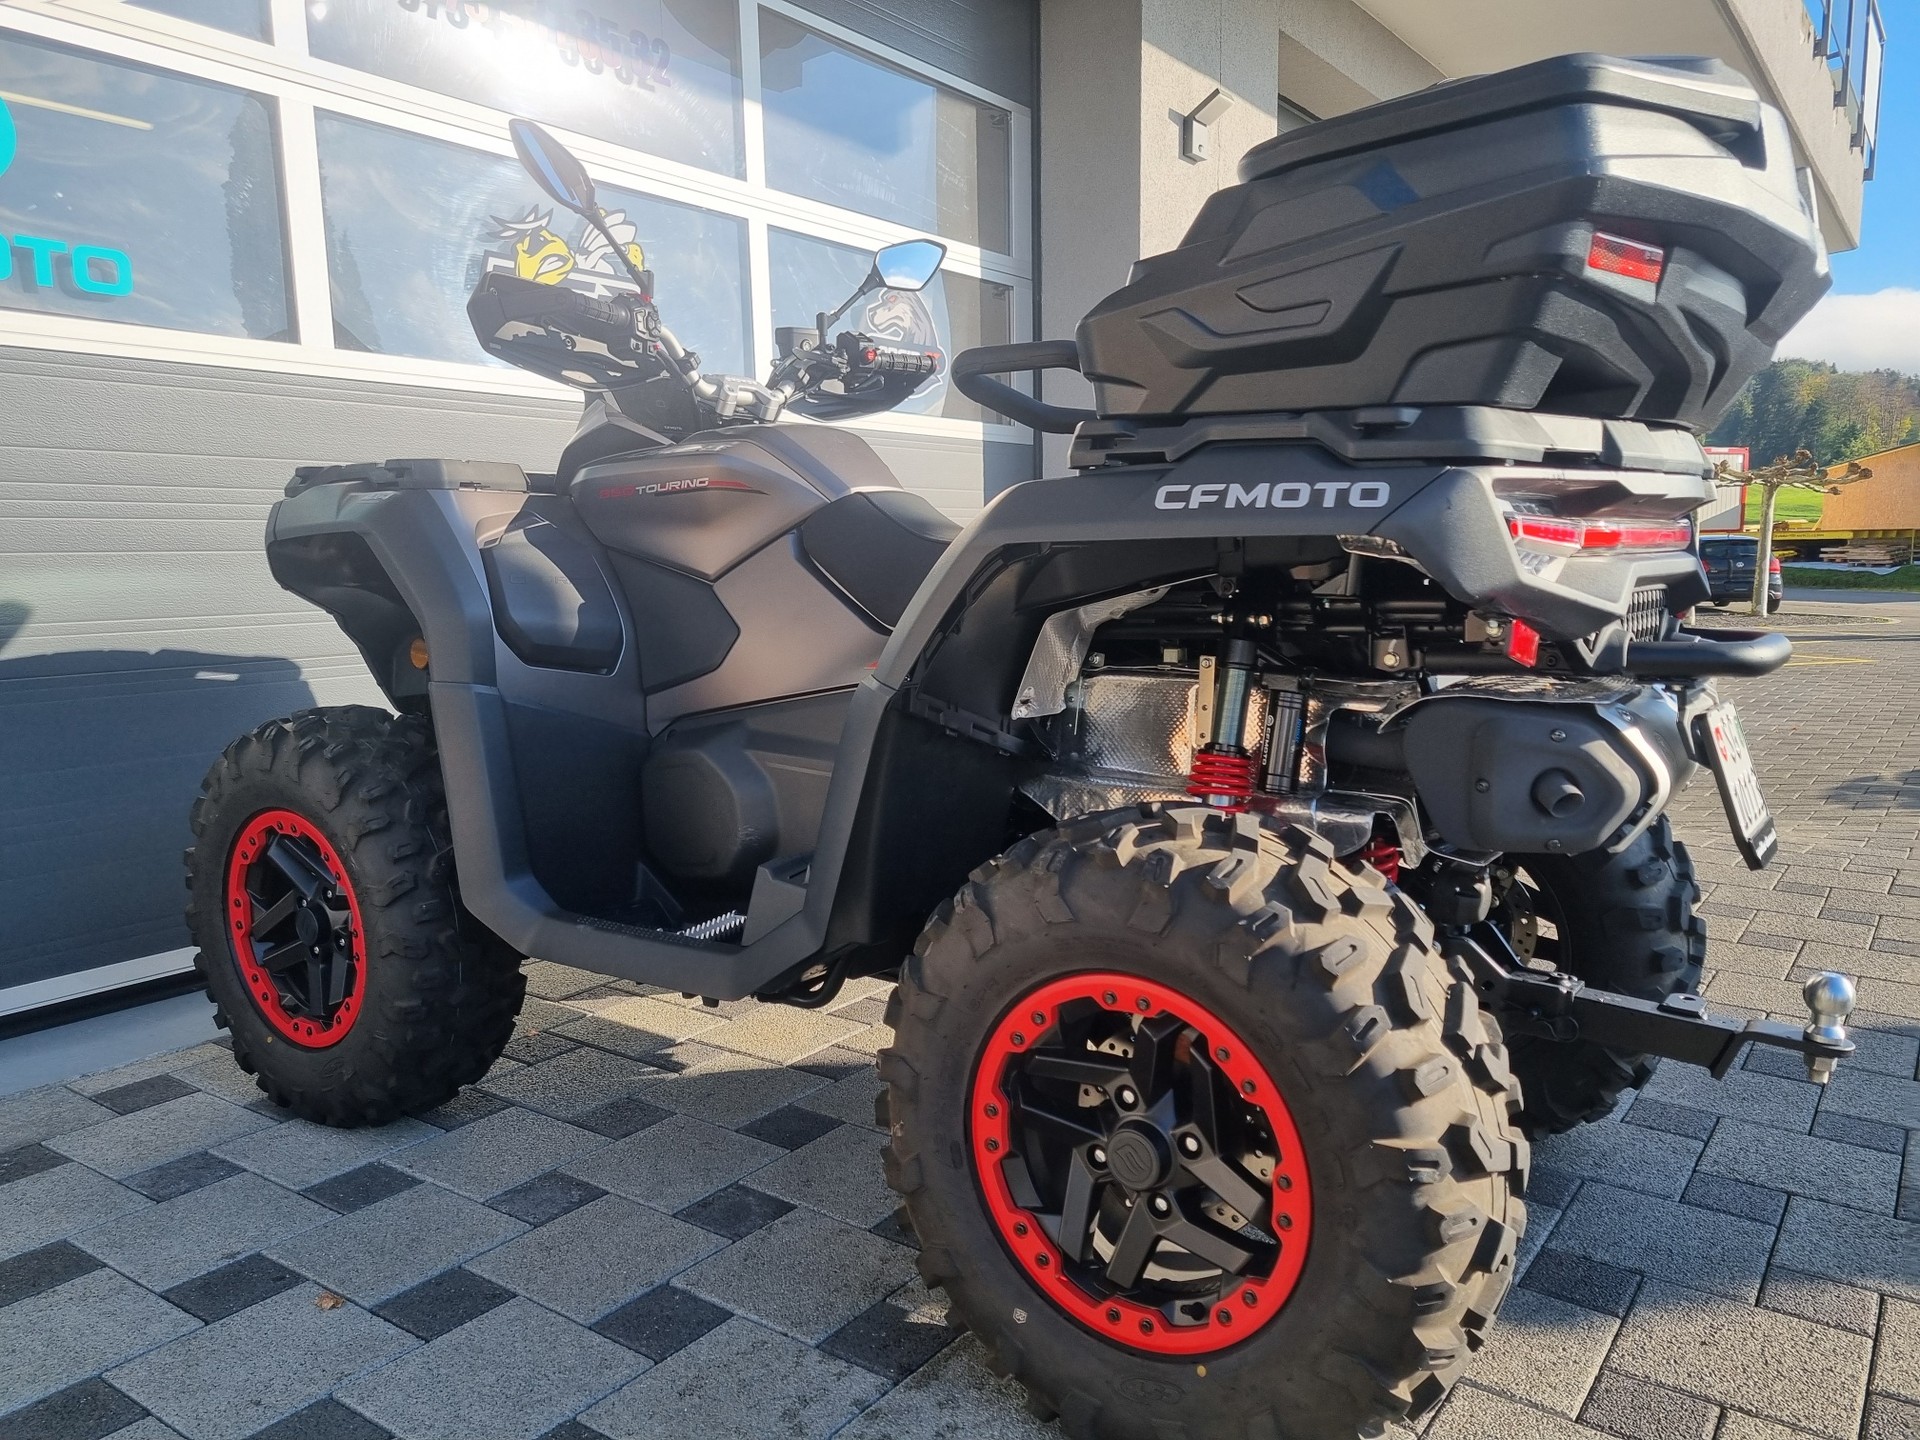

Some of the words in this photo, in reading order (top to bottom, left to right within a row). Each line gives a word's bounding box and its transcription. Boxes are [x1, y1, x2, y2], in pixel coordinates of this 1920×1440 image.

[0, 232, 134, 298] TO
[636, 477, 709, 495] TOURING
[1154, 481, 1391, 510] CFMOTO
